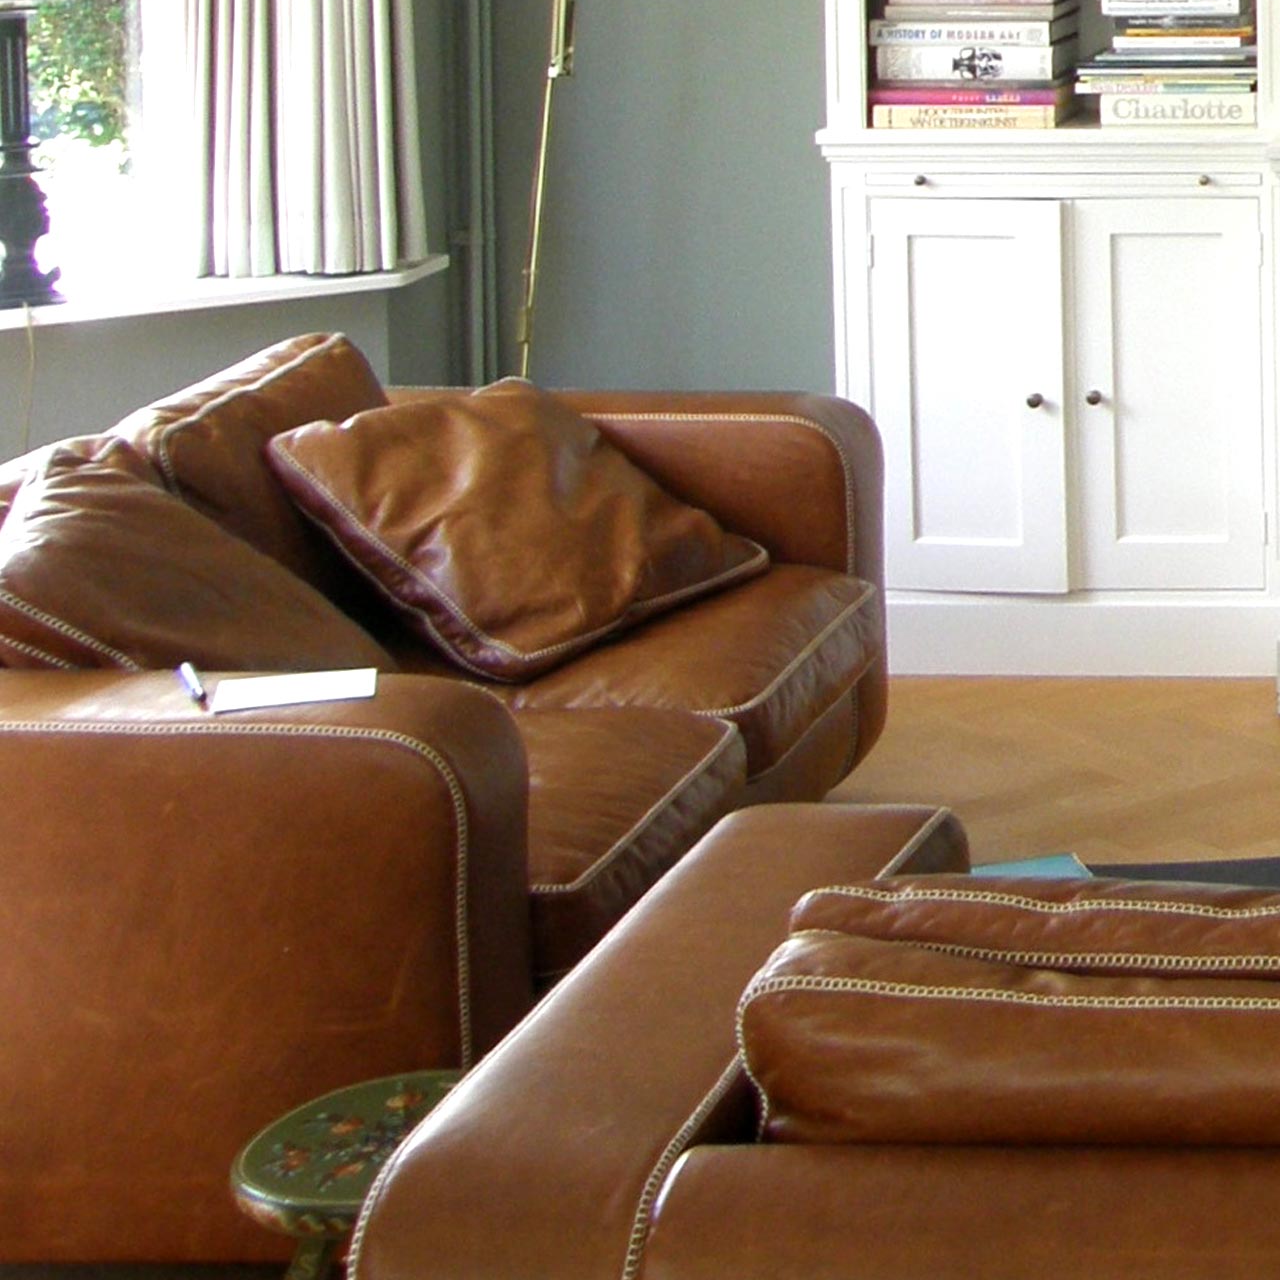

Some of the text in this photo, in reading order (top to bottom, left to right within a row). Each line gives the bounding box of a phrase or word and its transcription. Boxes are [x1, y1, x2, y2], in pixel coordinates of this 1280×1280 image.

[876, 29, 1021, 40] A HISTORY OF MODERN ART
[1112, 98, 1243, 120] Charlotte
